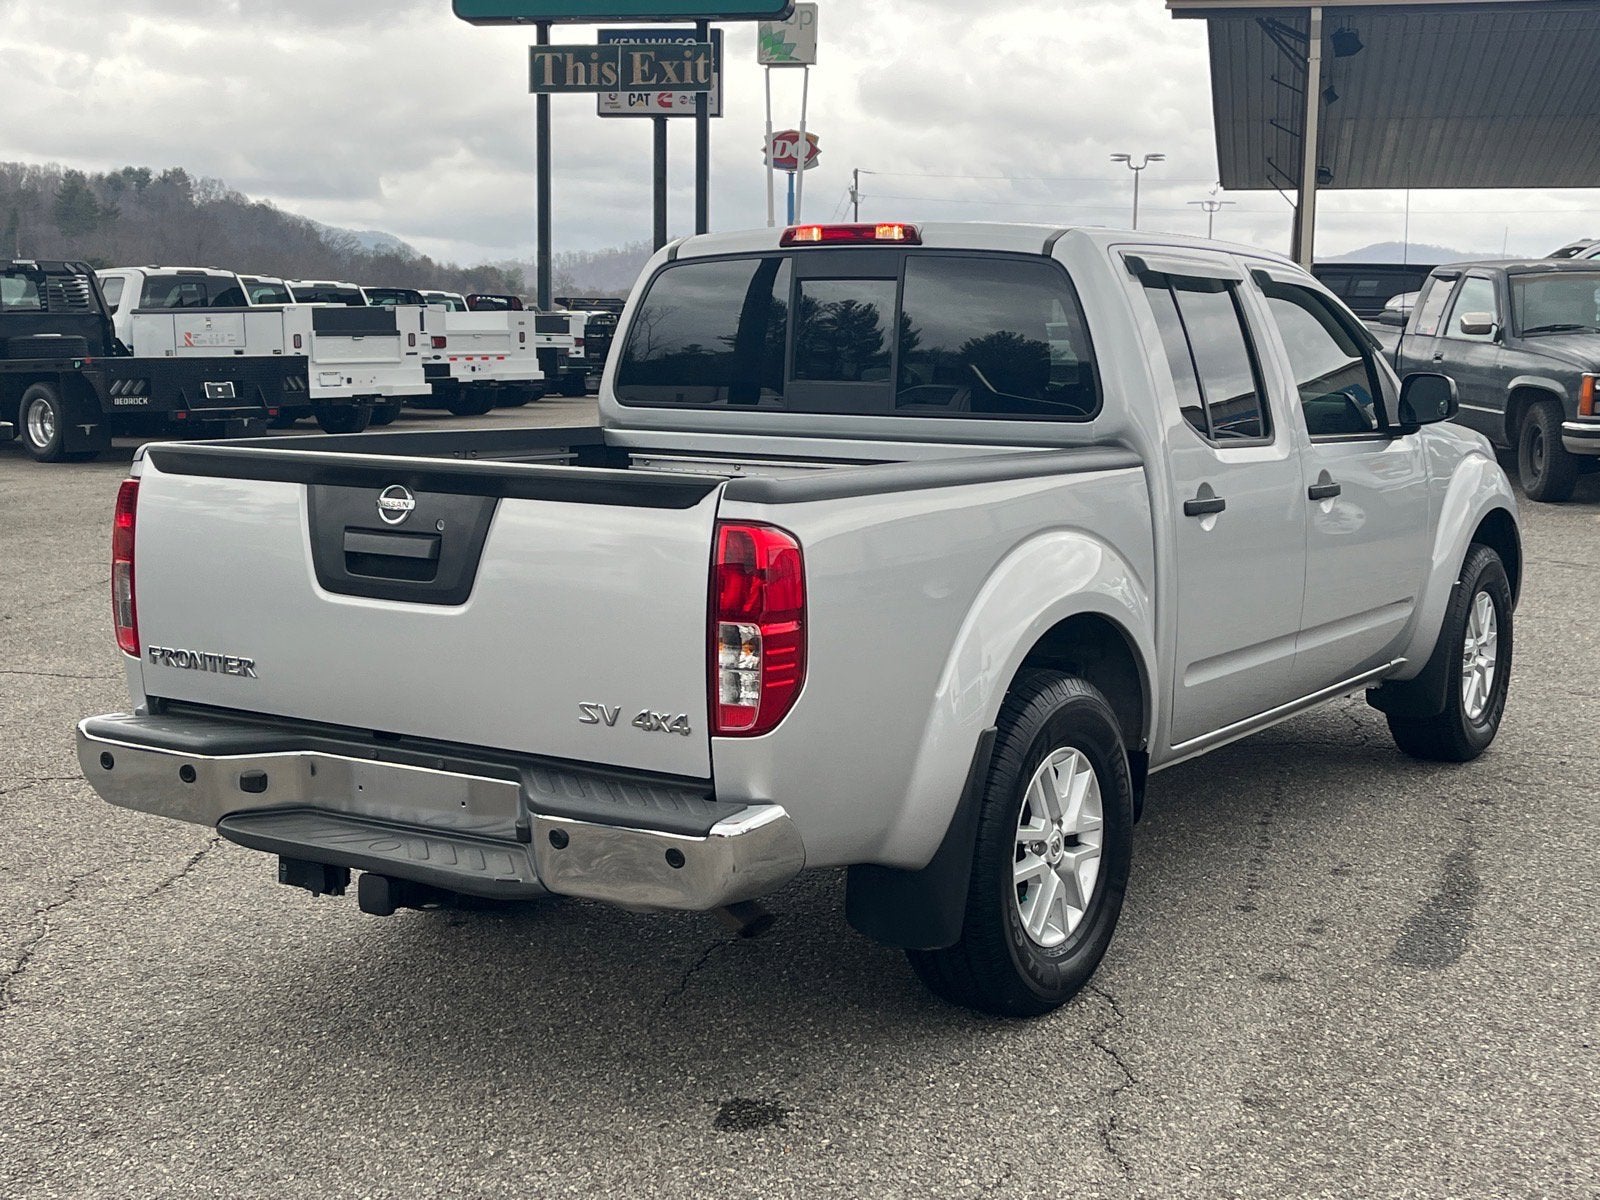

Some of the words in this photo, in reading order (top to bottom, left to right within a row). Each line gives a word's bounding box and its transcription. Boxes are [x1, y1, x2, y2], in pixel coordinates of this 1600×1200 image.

[534, 52, 617, 86] This
[628, 50, 710, 86] Exit
[628, 93, 651, 107] CAT
[773, 139, 811, 162] DQ
[114, 397, 149, 406] BEDROCK
[380, 499, 410, 509] NISSAN
[148, 644, 258, 679] FRONTIER
[579, 701, 621, 727] SV
